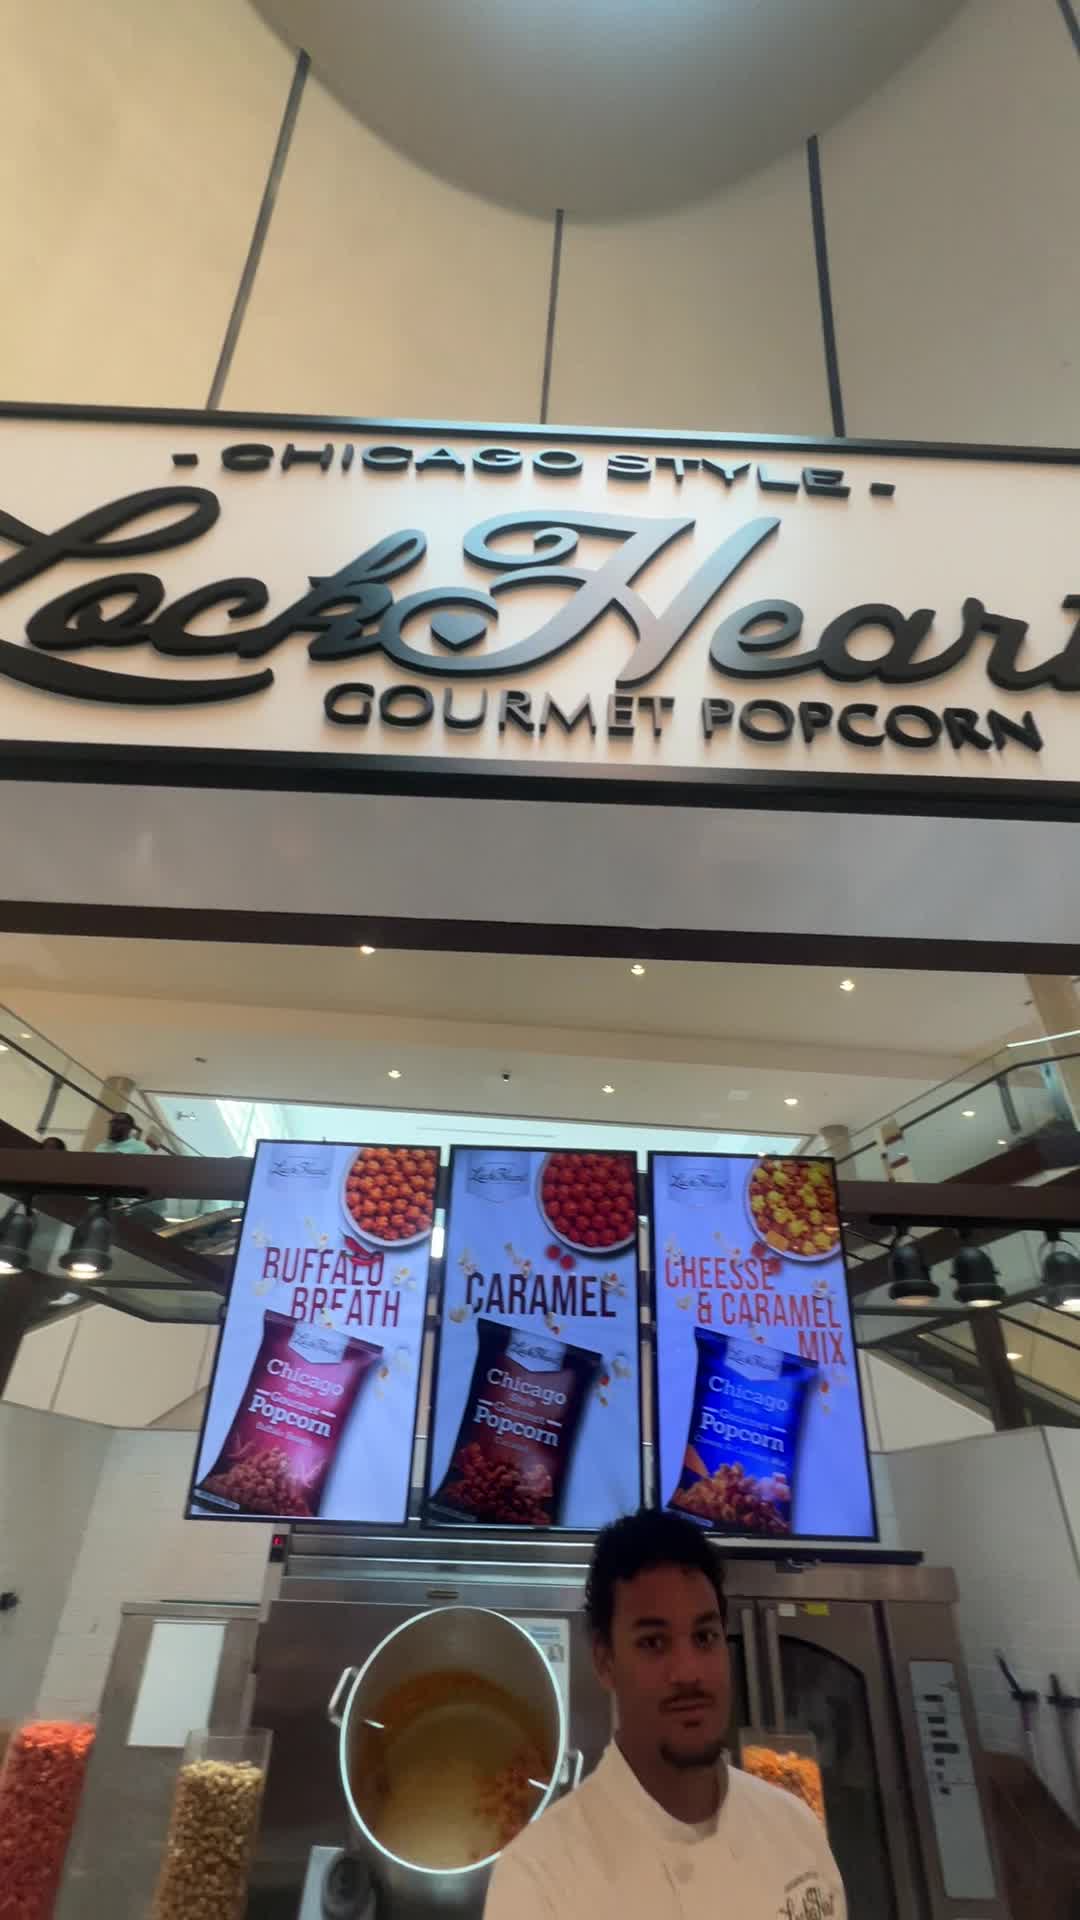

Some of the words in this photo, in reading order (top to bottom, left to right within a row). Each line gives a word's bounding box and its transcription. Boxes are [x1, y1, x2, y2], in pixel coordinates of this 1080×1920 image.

[221, 442, 584, 477] CHICAGO
[607, 453, 851, 498] STYLE
[323, 682, 675, 738] GOURMET
[700, 697, 1044, 753] POPCORN
[263, 1246, 385, 1287] BUFFALO
[465, 1271, 617, 1318] CARAMEL
[696, 1292, 713, 1325] &
[720, 1292, 842, 1329] CARAMEL
[797, 1330, 848, 1365] MIX
[266, 1358, 345, 1397] Chicago
[487, 1368, 568, 1406] Chicago
[708, 1375, 789, 1413] Chicago
[247, 1394, 332, 1438] Popcorn
[472, 1404, 559, 1448] Popcorn
[699, 1411, 785, 1453] Popcorn
